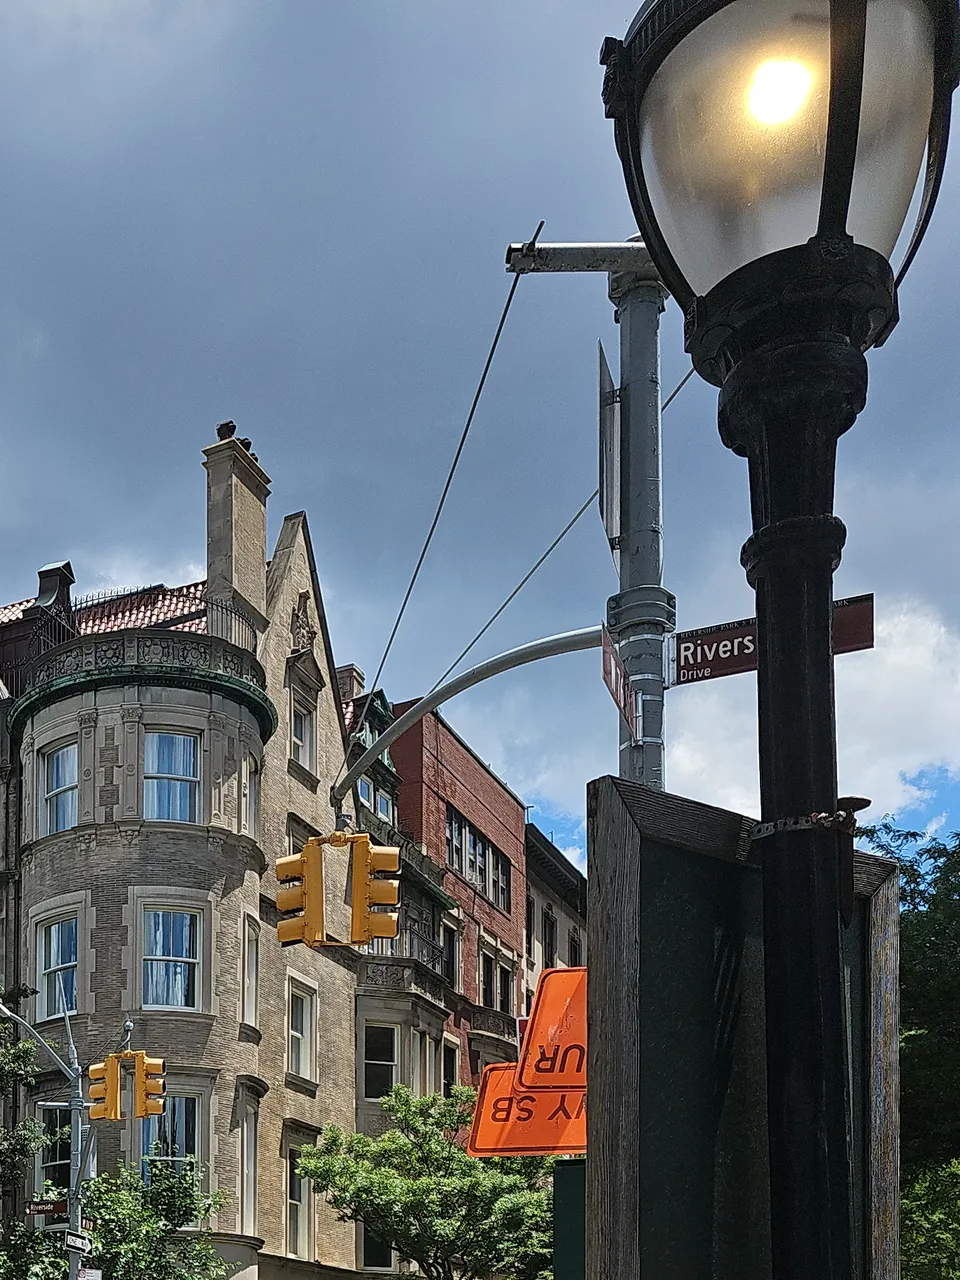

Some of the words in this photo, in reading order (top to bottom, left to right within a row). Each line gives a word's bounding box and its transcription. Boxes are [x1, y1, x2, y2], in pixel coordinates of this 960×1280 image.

[680, 635, 755, 666] Rivers
[680, 667, 711, 682] Drive
[535, 1044, 586, 1073] UR
[490, 1095, 537, 1123] SB
[30, 1203, 54, 1211] Riverside
[68, 1236, 78, 1246] ONE
